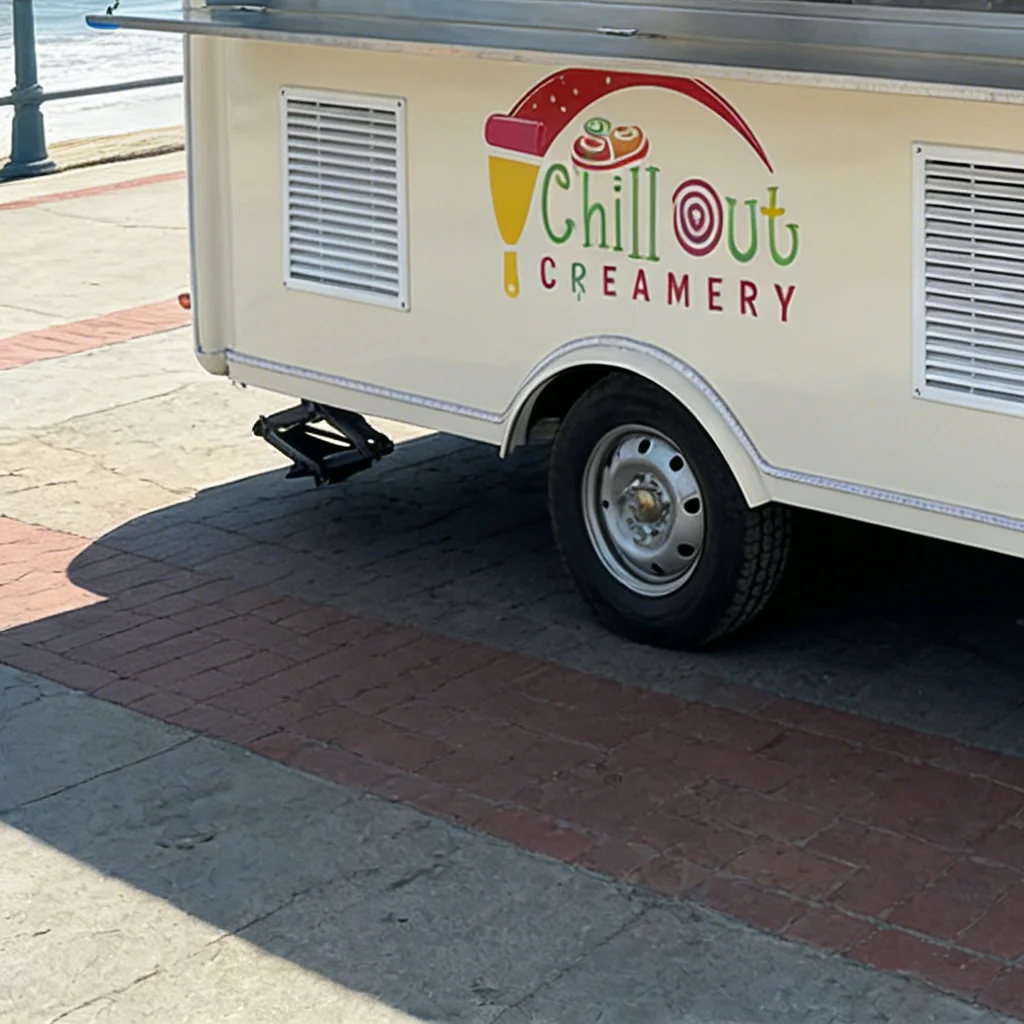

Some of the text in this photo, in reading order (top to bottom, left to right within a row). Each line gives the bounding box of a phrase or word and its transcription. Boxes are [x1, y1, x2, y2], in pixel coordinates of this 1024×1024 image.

[541, 163, 799, 266] Chill Out
[540, 256, 796, 323] CREAMERY
